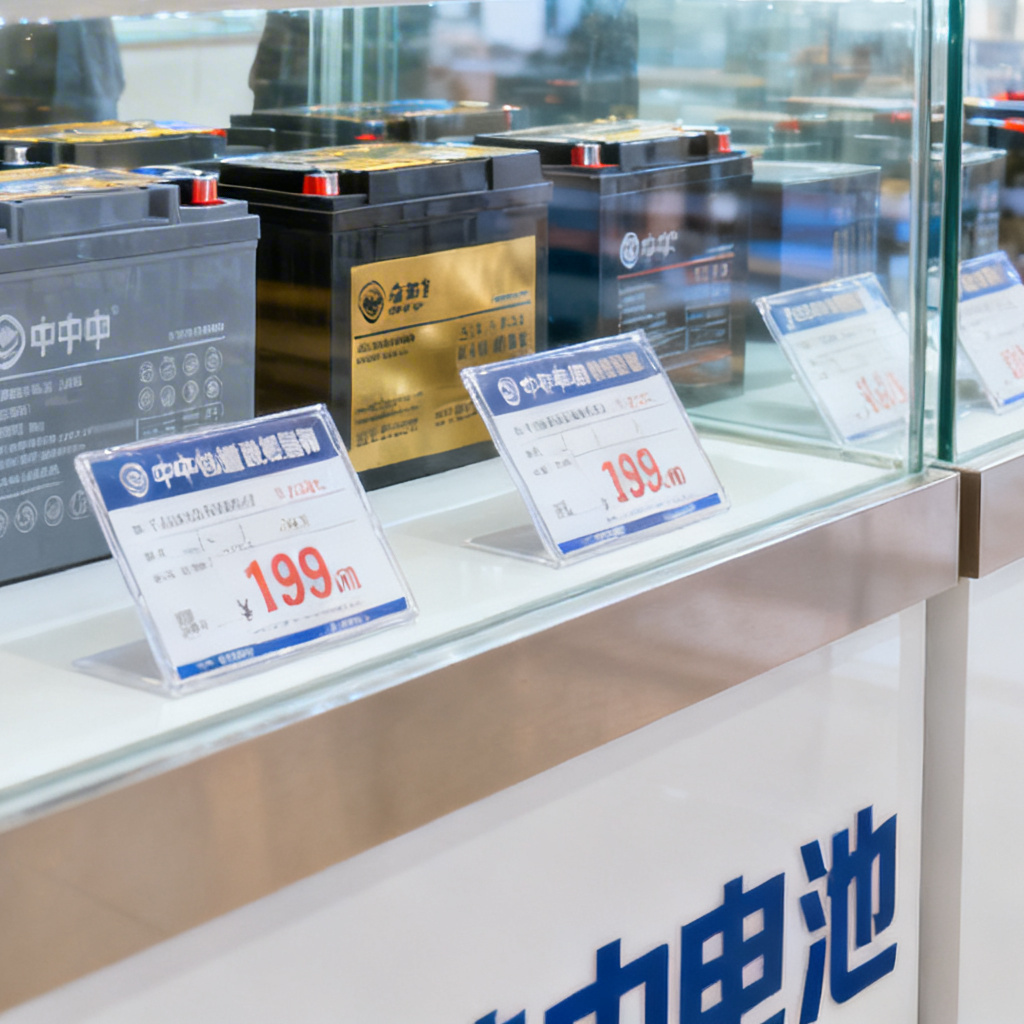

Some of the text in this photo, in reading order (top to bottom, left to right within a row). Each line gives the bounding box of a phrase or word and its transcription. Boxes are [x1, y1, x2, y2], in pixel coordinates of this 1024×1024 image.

[602, 448, 663, 503] 199
[244, 546, 332, 613] 199
[474, 805, 898, 1024] 电池
